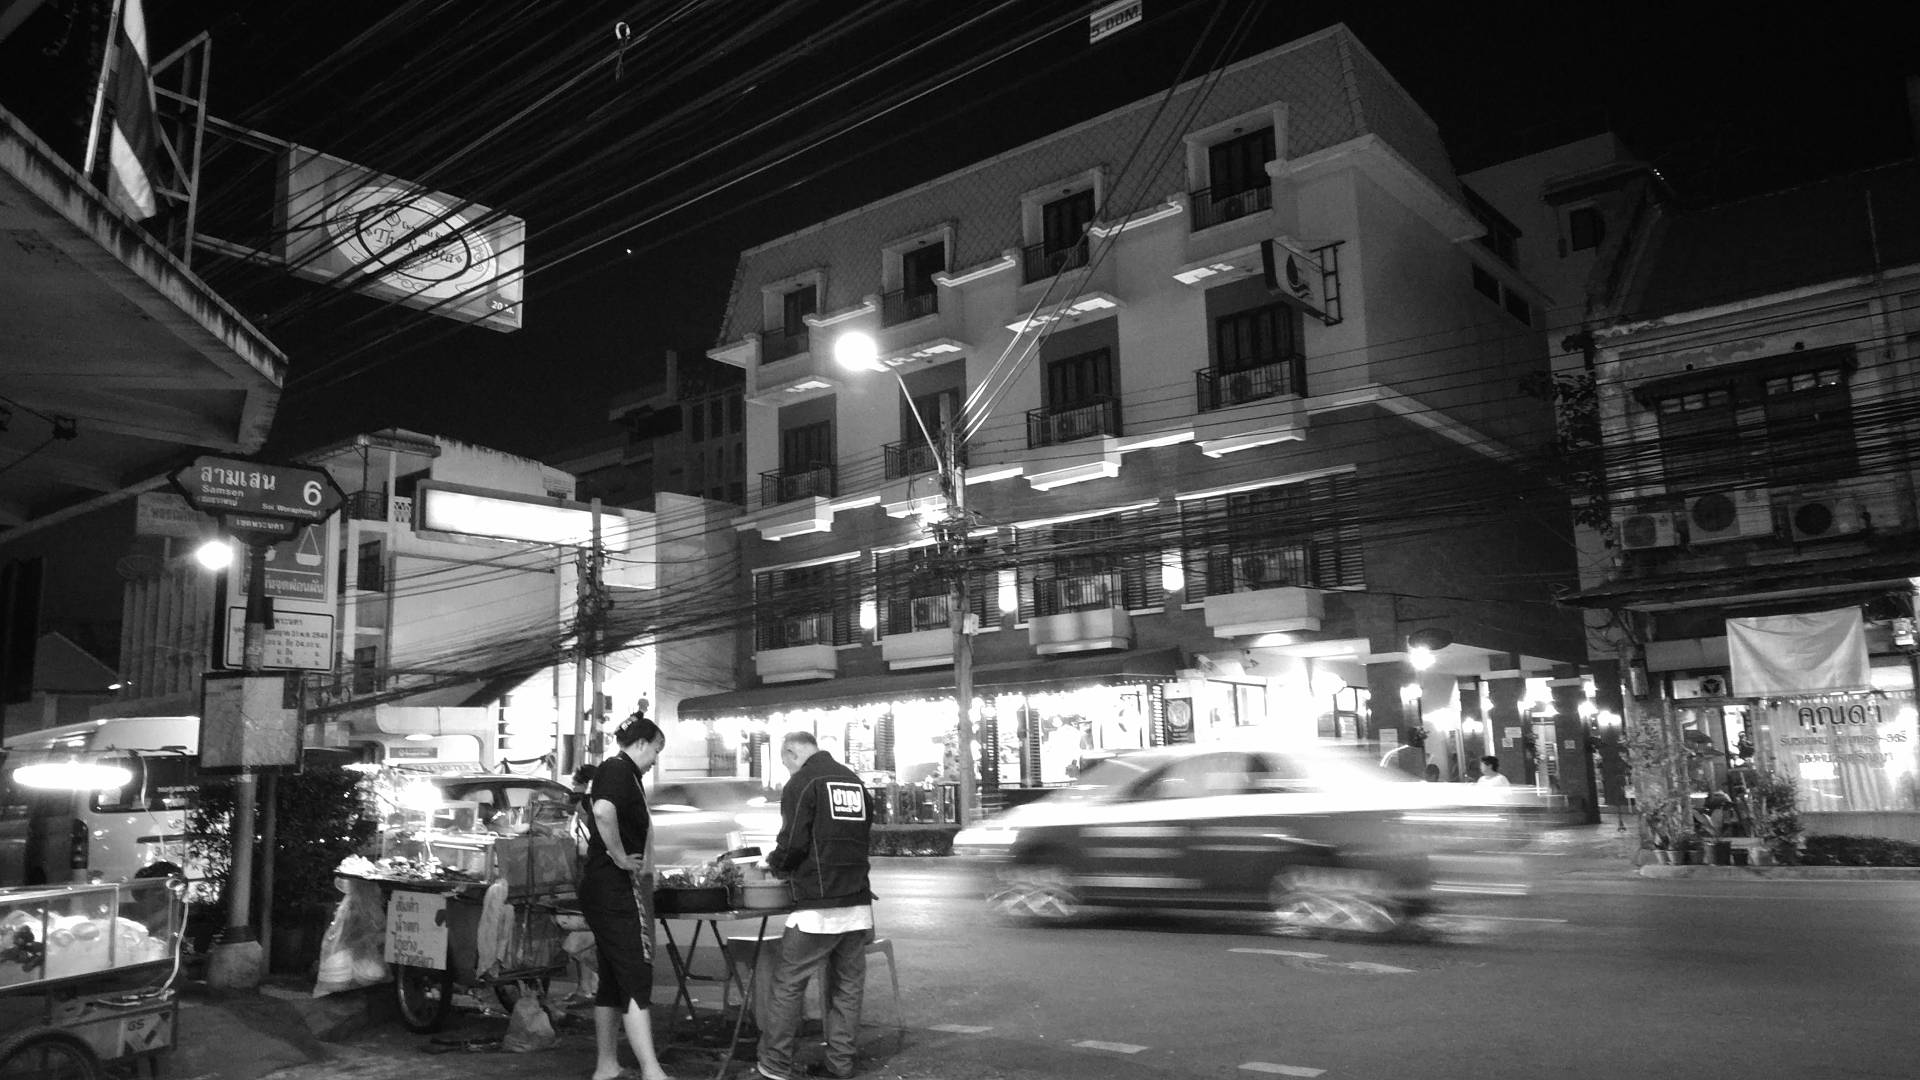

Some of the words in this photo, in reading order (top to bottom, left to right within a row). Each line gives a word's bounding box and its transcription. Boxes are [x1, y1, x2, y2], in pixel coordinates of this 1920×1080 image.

[201, 466, 276, 491] สามเสน
[202, 485, 244, 497] Samsen
[303, 480, 322, 506] 6
[1798, 704, 1883, 733] คุณดา
